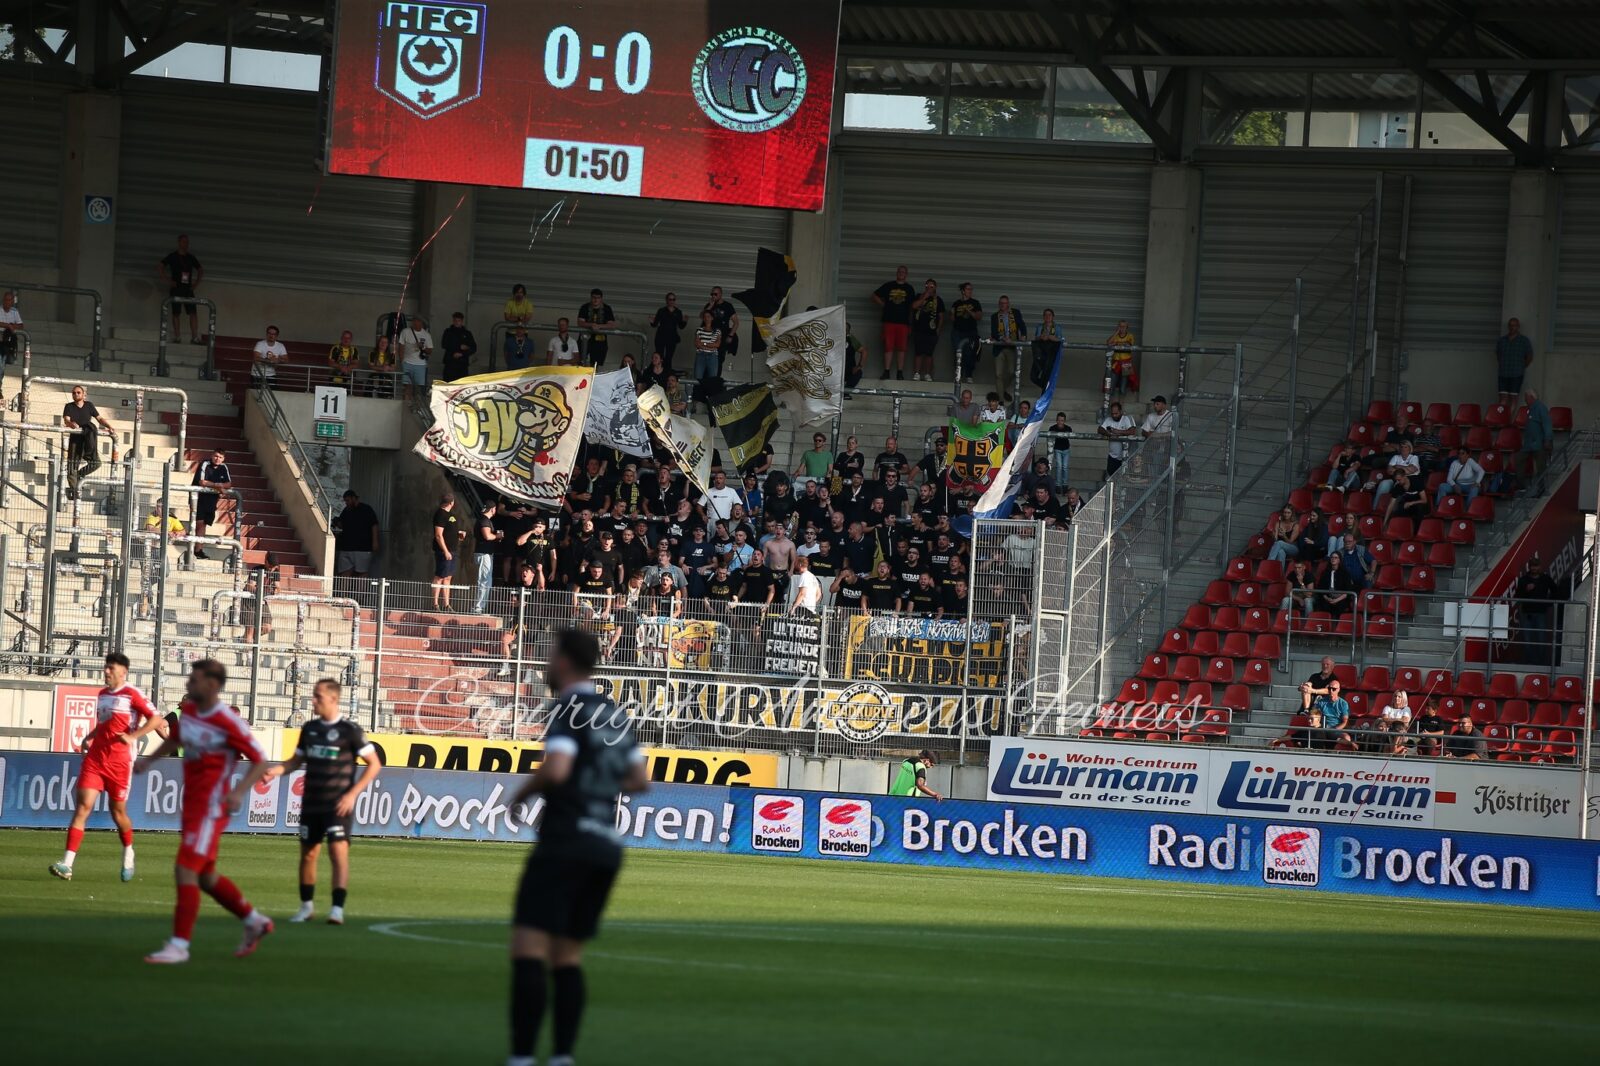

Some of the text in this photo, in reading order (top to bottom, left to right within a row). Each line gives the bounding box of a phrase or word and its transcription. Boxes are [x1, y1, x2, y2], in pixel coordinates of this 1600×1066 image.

[391, 4, 473, 33] HFC
[544, 25, 652, 95] 0:0
[708, 42, 798, 114] VFC
[545, 145, 630, 181] 01:50
[321, 395, 338, 413] 11
[773, 622, 818, 639] ULTRAS
[926, 624, 990, 643] NORDHASEN
[765, 639, 819, 657] FREUNDE
[764, 657, 818, 675] FREIHEIT
[68, 701, 93, 716] HFC
[831, 704, 896, 720] BADKURVE
[1065, 753, 1198, 770] Wohn-Centrum
[991, 747, 1200, 799] Lührmann
[1293, 766, 1430, 785] Wohn-Centrum
[1217, 760, 1432, 813] Lührmann
[1069, 792, 1192, 807] an der Saline
[249, 811, 276, 824] Brocken
[355, 779, 393, 825] dio
[616, 795, 734, 843] ören!
[1297, 807, 1424, 822] an der Saline
[762, 823, 791, 836] Radio
[828, 828, 858, 839] Radio
[902, 808, 1088, 861] Brocken
[754, 835, 800, 849] Brocken
[821, 839, 868, 854] Brocken
[1148, 823, 1251, 872] Radi
[1274, 857, 1306, 868] Radio
[1333, 836, 1530, 892] Brocken
[1266, 867, 1316, 883] Brocken
